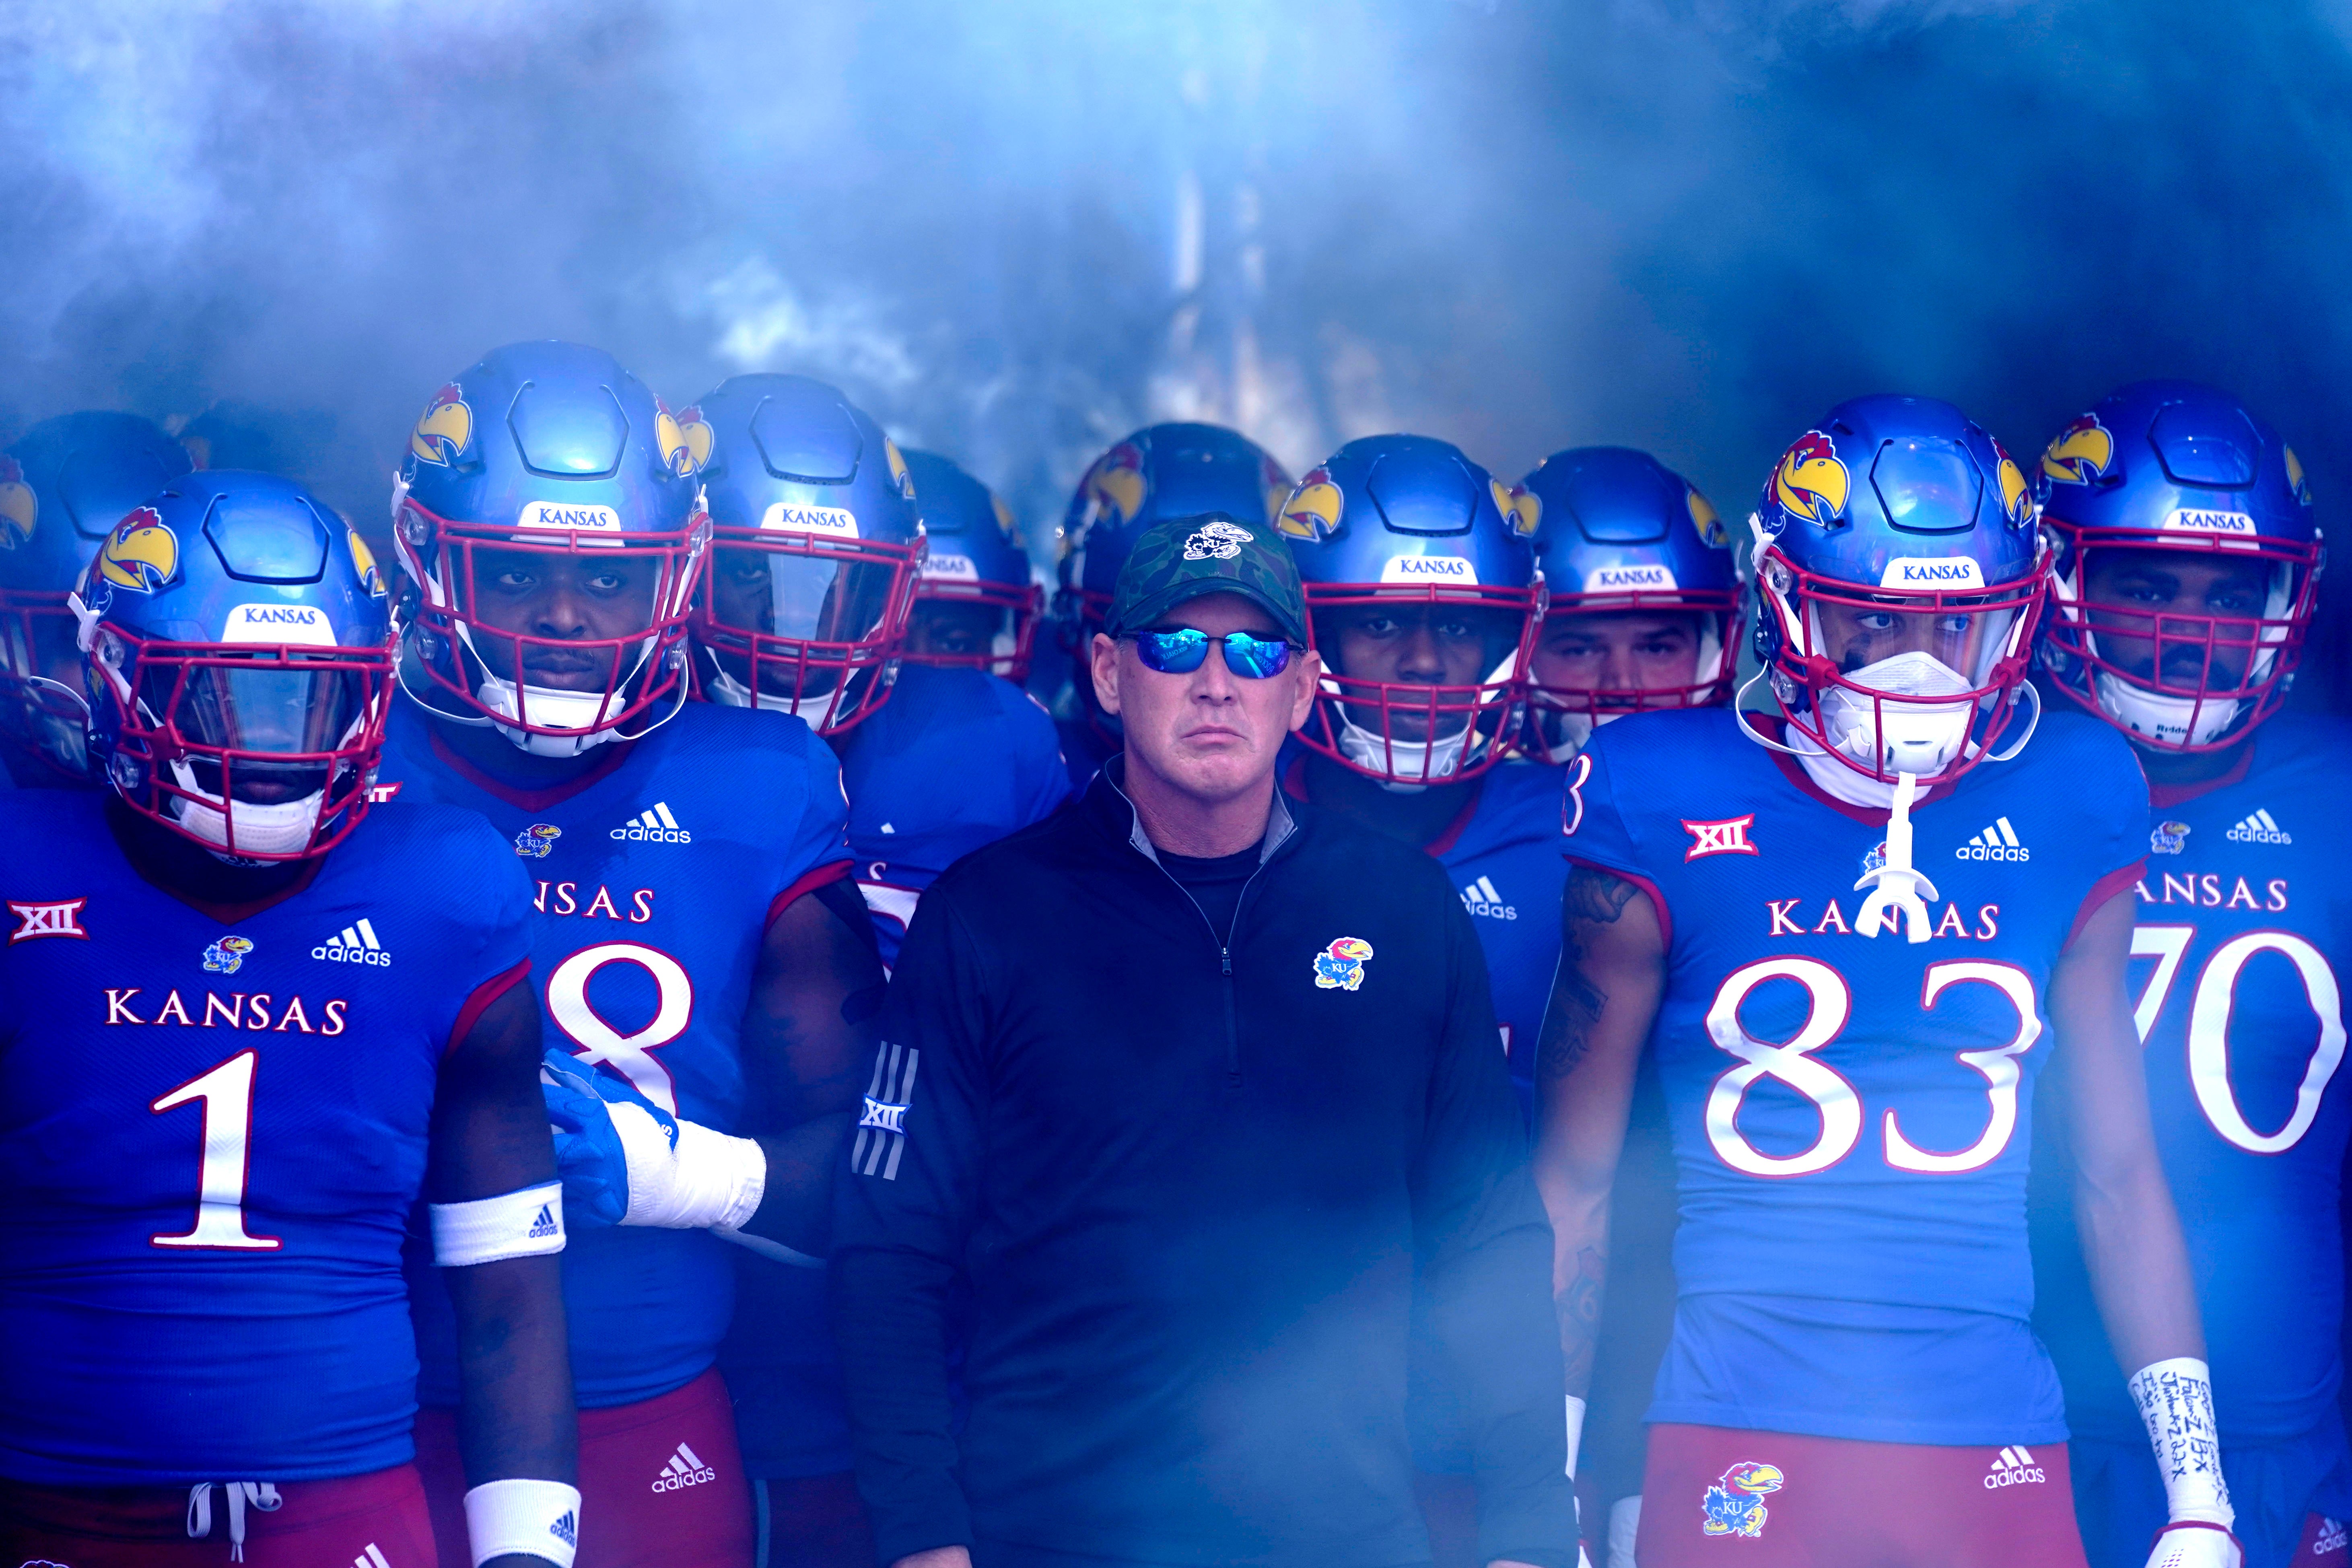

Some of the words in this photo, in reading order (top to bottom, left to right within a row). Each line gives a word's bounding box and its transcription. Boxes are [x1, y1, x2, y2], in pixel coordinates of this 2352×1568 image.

[538, 508, 606, 527] KANSAS
[782, 508, 846, 528] KANSAS
[2180, 511, 2245, 531] KANSAS
[1203, 540, 1221, 549] KU
[1400, 559, 1464, 575] KANSAS
[1600, 569, 1664, 585] KANSAS
[1903, 565, 1970, 580] KANSAS
[244, 608, 315, 624] KANSAS
[527, 839, 540, 848] KU
[610, 826, 691, 844] adidas
[1687, 818, 1754, 857] XII
[2226, 827, 2292, 845] adidas
[1956, 843, 2029, 862] adidas
[2134, 872, 2288, 912] ANSAS
[11, 900, 84, 940] XII
[216, 952, 231, 963] KU
[311, 944, 391, 967] adidas
[1331, 963, 1347, 973] KU
[104, 988, 348, 1036] KANSAS
[544, 940, 695, 1119] 8
[2129, 922, 2347, 1157] 70
[1702, 954, 2043, 1179] 83
[859, 1096, 907, 1134] XII
[148, 1047, 284, 1251] 1
[529, 1215, 558, 1238] adidas
[651, 1467, 716, 1493] adidas
[1984, 1465, 2045, 1490] adidas
[1723, 1501, 1744, 1516] KU
[550, 1523, 576, 1548] adidas
